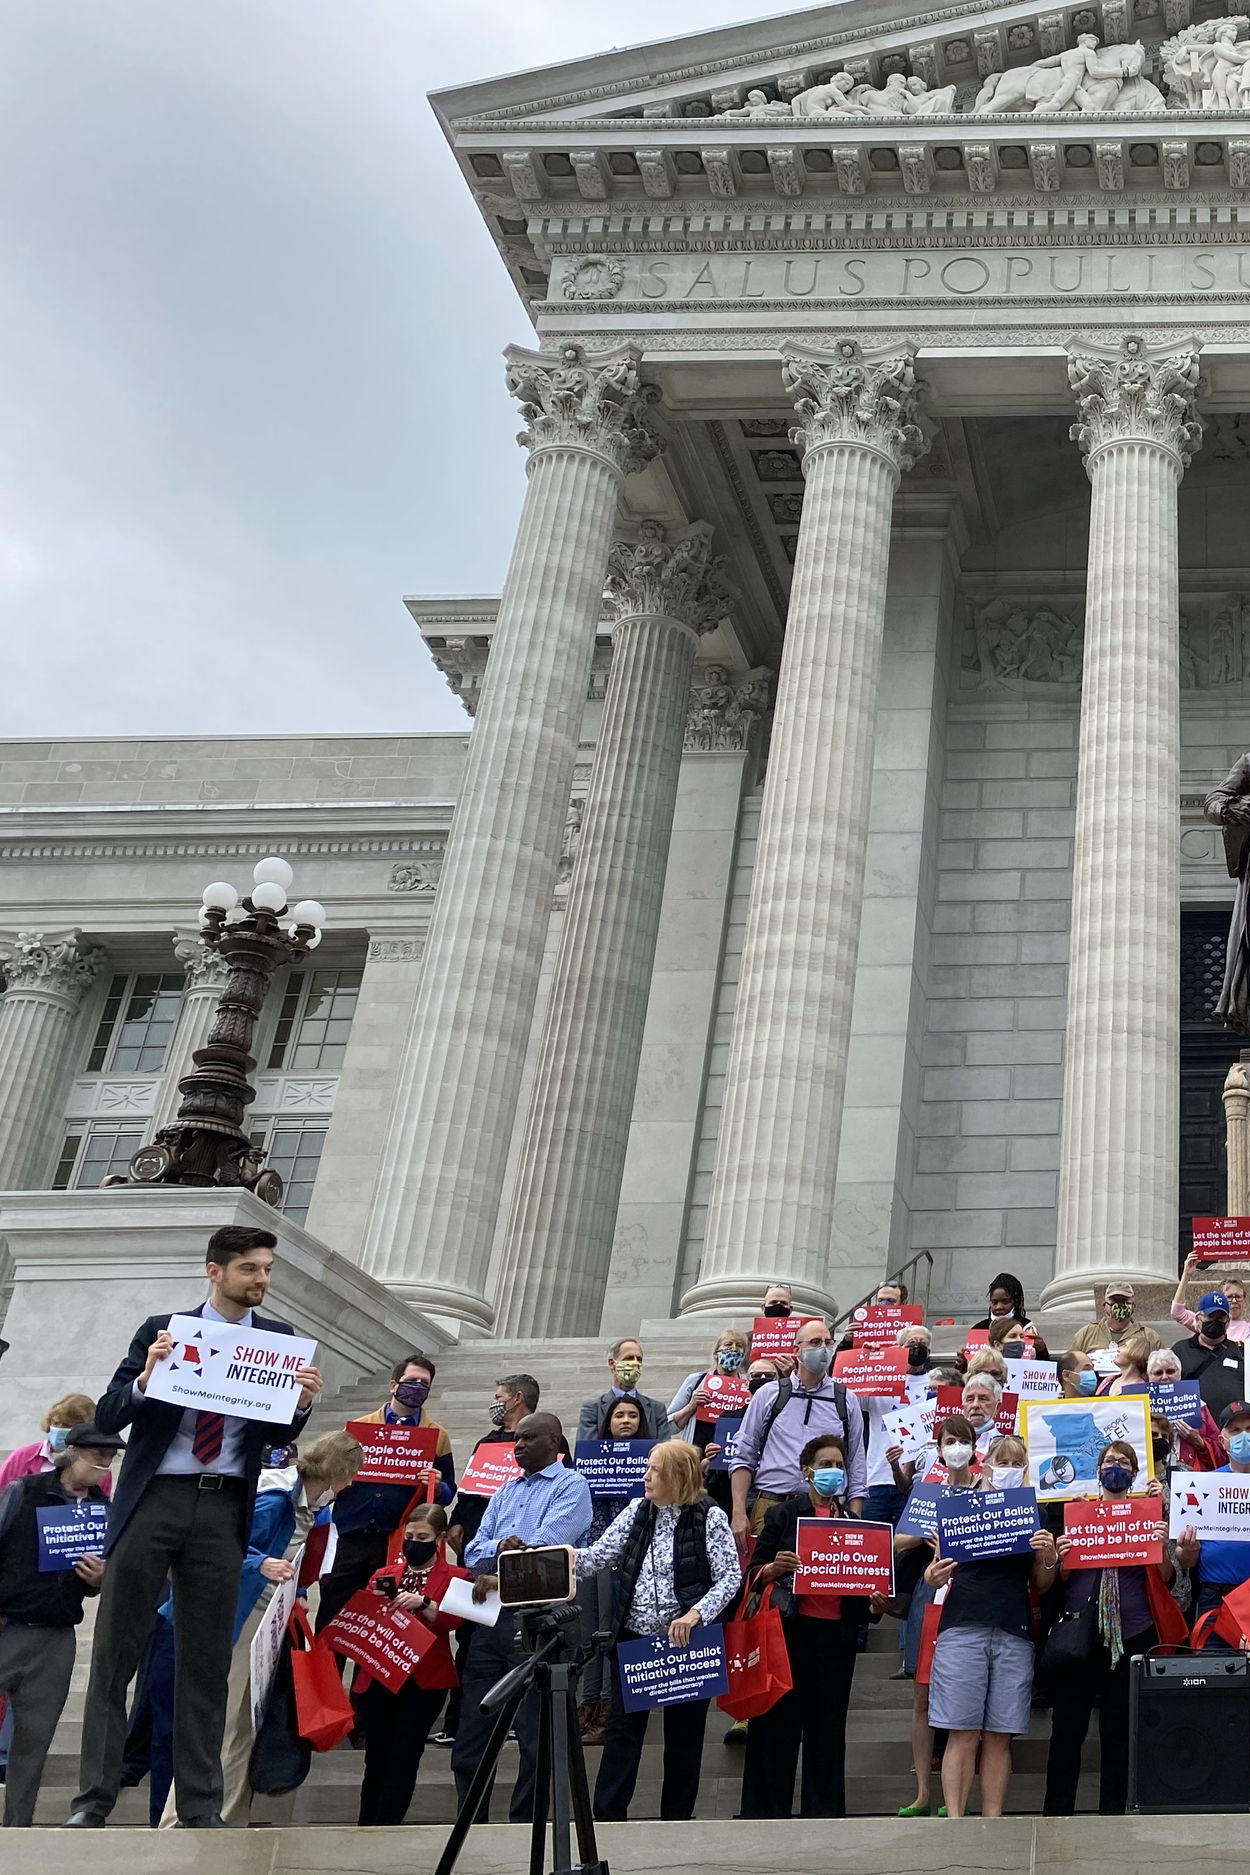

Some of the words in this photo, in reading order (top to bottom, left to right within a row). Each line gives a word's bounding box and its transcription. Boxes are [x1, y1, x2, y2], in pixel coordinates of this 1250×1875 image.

[641, 258, 867, 298] SALUS
[900, 254, 1158, 296] POPULI
[1206, 1231, 1220, 1239] the
[1193, 1239, 1220, 1248] people
[863, 1321, 892, 1329] People
[781, 1331, 796, 1339] will
[853, 1329, 885, 1339] Special
[751, 1340, 779, 1349] people
[233, 1346, 279, 1367] SHOW
[282, 1355, 305, 1371] ME
[842, 1365, 873, 1374] People
[874, 1364, 897, 1372] Over
[1023, 1370, 1047, 1380] SHOW
[226, 1364, 297, 1390] INTEGRITY
[831, 1375, 865, 1384] Special
[866, 1373, 907, 1382] Interests
[1022, 1381, 1059, 1392] INTEGRITY
[172, 1385, 271, 1411] ShowMeIntegrity.org
[712, 1391, 743, 1403] People
[1157, 1397, 1172, 1405] Our
[1173, 1393, 1197, 1403] Ballot
[936, 1405, 950, 1413] Let
[1165, 1402, 1197, 1412] Process
[1000, 1411, 1015, 1420] the
[1103, 1413, 1128, 1433] PEOPLE
[396, 1446, 423, 1457] Over
[384, 1458, 433, 1469] Interests
[576, 1458, 607, 1466] Protect
[609, 1457, 625, 1465] Our
[483, 1462, 518, 1474] People
[466, 1468, 505, 1482] Special
[1219, 1487, 1249, 1500] SHOW
[941, 1512, 981, 1527] Protect
[982, 1510, 1002, 1520] Our
[1004, 1505, 1035, 1517] Ballot
[43, 1523, 85, 1534] Protect
[87, 1522, 104, 1530] Our
[944, 1521, 992, 1537] Initiative
[994, 1516, 1035, 1529] Process
[1065, 1525, 1082, 1535] Let
[1085, 1523, 1104, 1533] the
[1106, 1522, 1126, 1532] will
[1128, 1520, 1141, 1531] of
[45, 1532, 94, 1544] Initiative
[983, 1537, 1018, 1547] democracy!
[1107, 1534, 1122, 1544] be
[811, 1551, 850, 1563] People
[852, 1552, 878, 1563] Over
[1080, 1551, 1147, 1561] ShowMeIntegrity.org
[796, 1564, 840, 1576] Special
[842, 1565, 890, 1576] Interests
[339, 1608, 357, 1620] Let
[357, 1614, 375, 1628] the
[376, 1624, 394, 1641] will
[393, 1638, 405, 1649] of
[403, 1647, 420, 1663] the
[329, 1619, 368, 1638] people
[368, 1633, 382, 1648] be
[382, 1644, 411, 1674] heard.
[624, 1658, 665, 1673] Protect
[667, 1653, 687, 1664] Our
[690, 1646, 721, 1659] Ballot
[627, 1667, 676, 1684] Initiative
[679, 1658, 721, 1673] Process
[649, 1688, 668, 1696] direct
